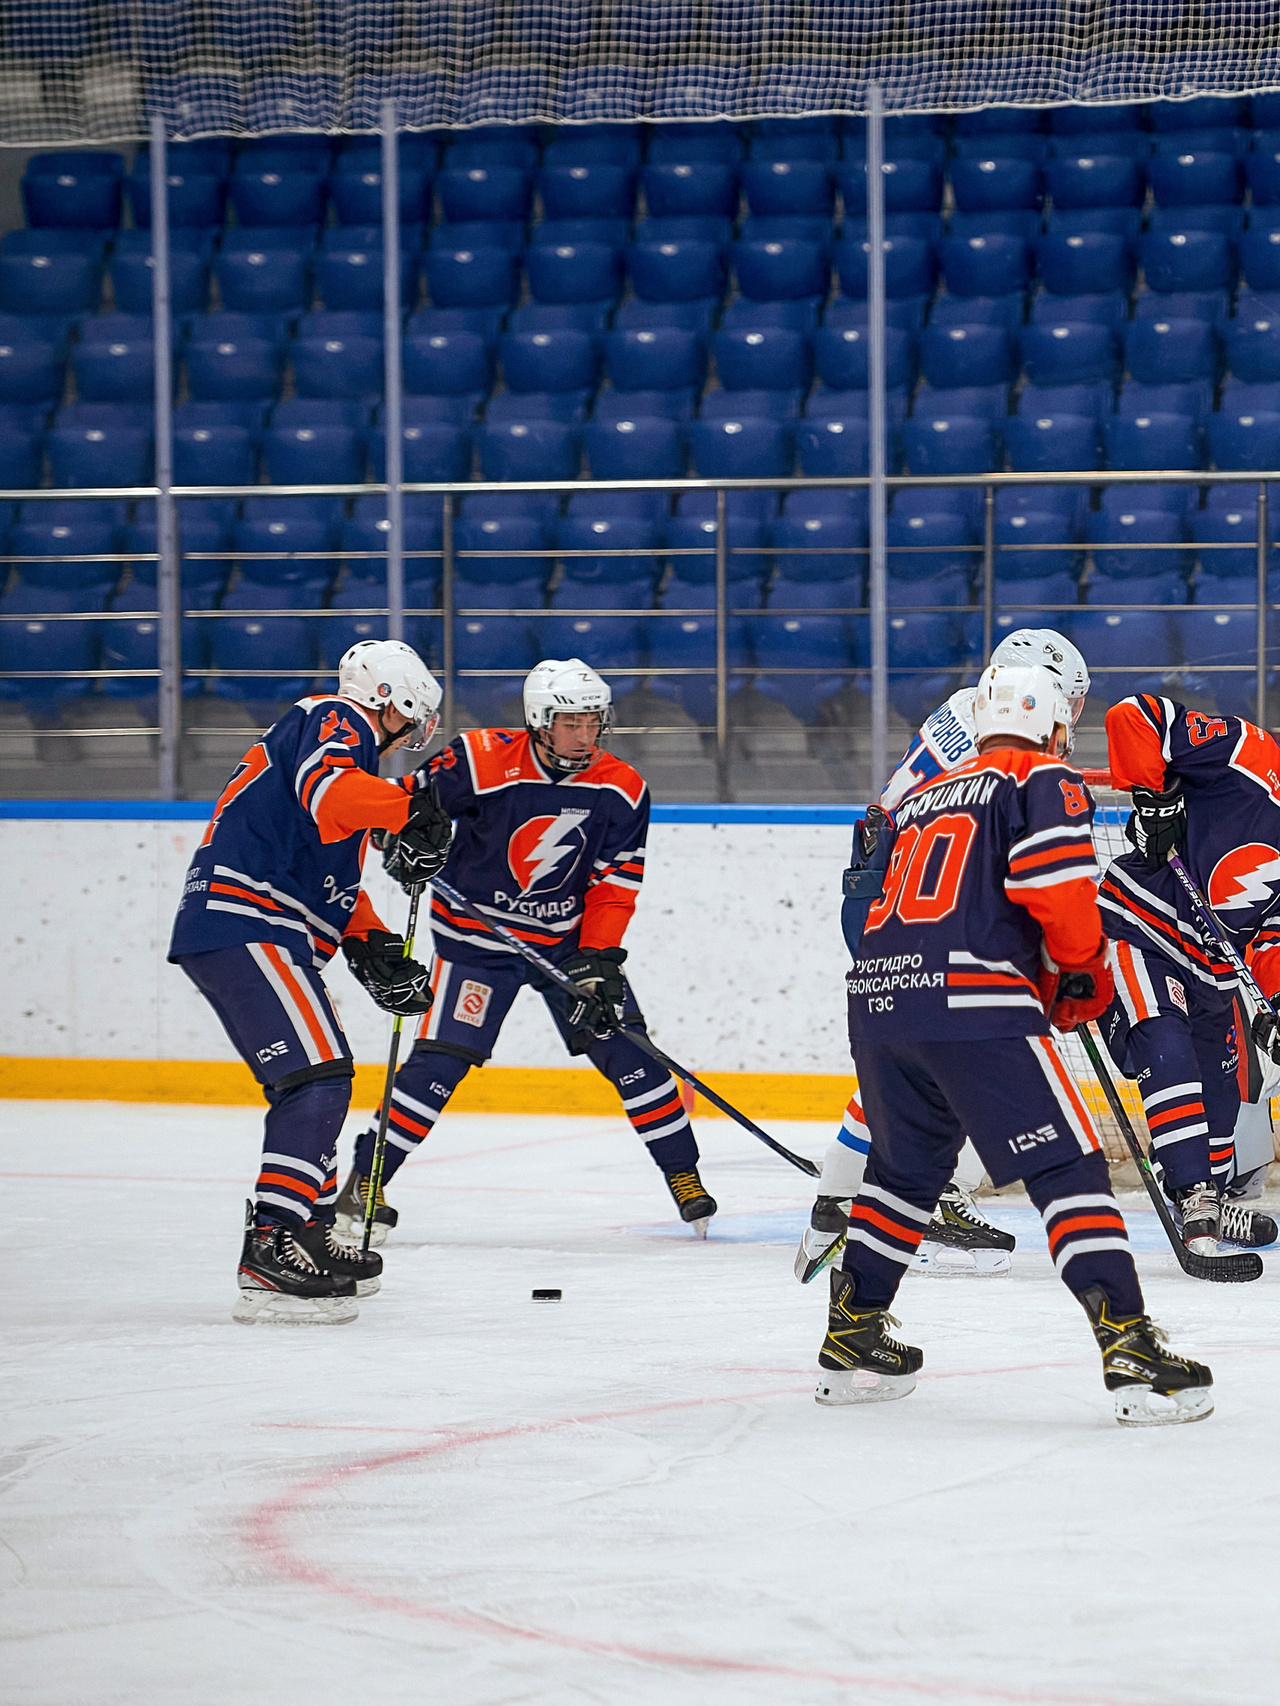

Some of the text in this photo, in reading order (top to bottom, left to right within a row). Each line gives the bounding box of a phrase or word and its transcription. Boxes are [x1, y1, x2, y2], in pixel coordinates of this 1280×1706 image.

[926, 701, 973, 763] РОНОВ
[868, 995, 894, 1013] ГЭС
[870, 1349, 898, 1364] CCM
[1111, 1357, 1158, 1380] CCM
